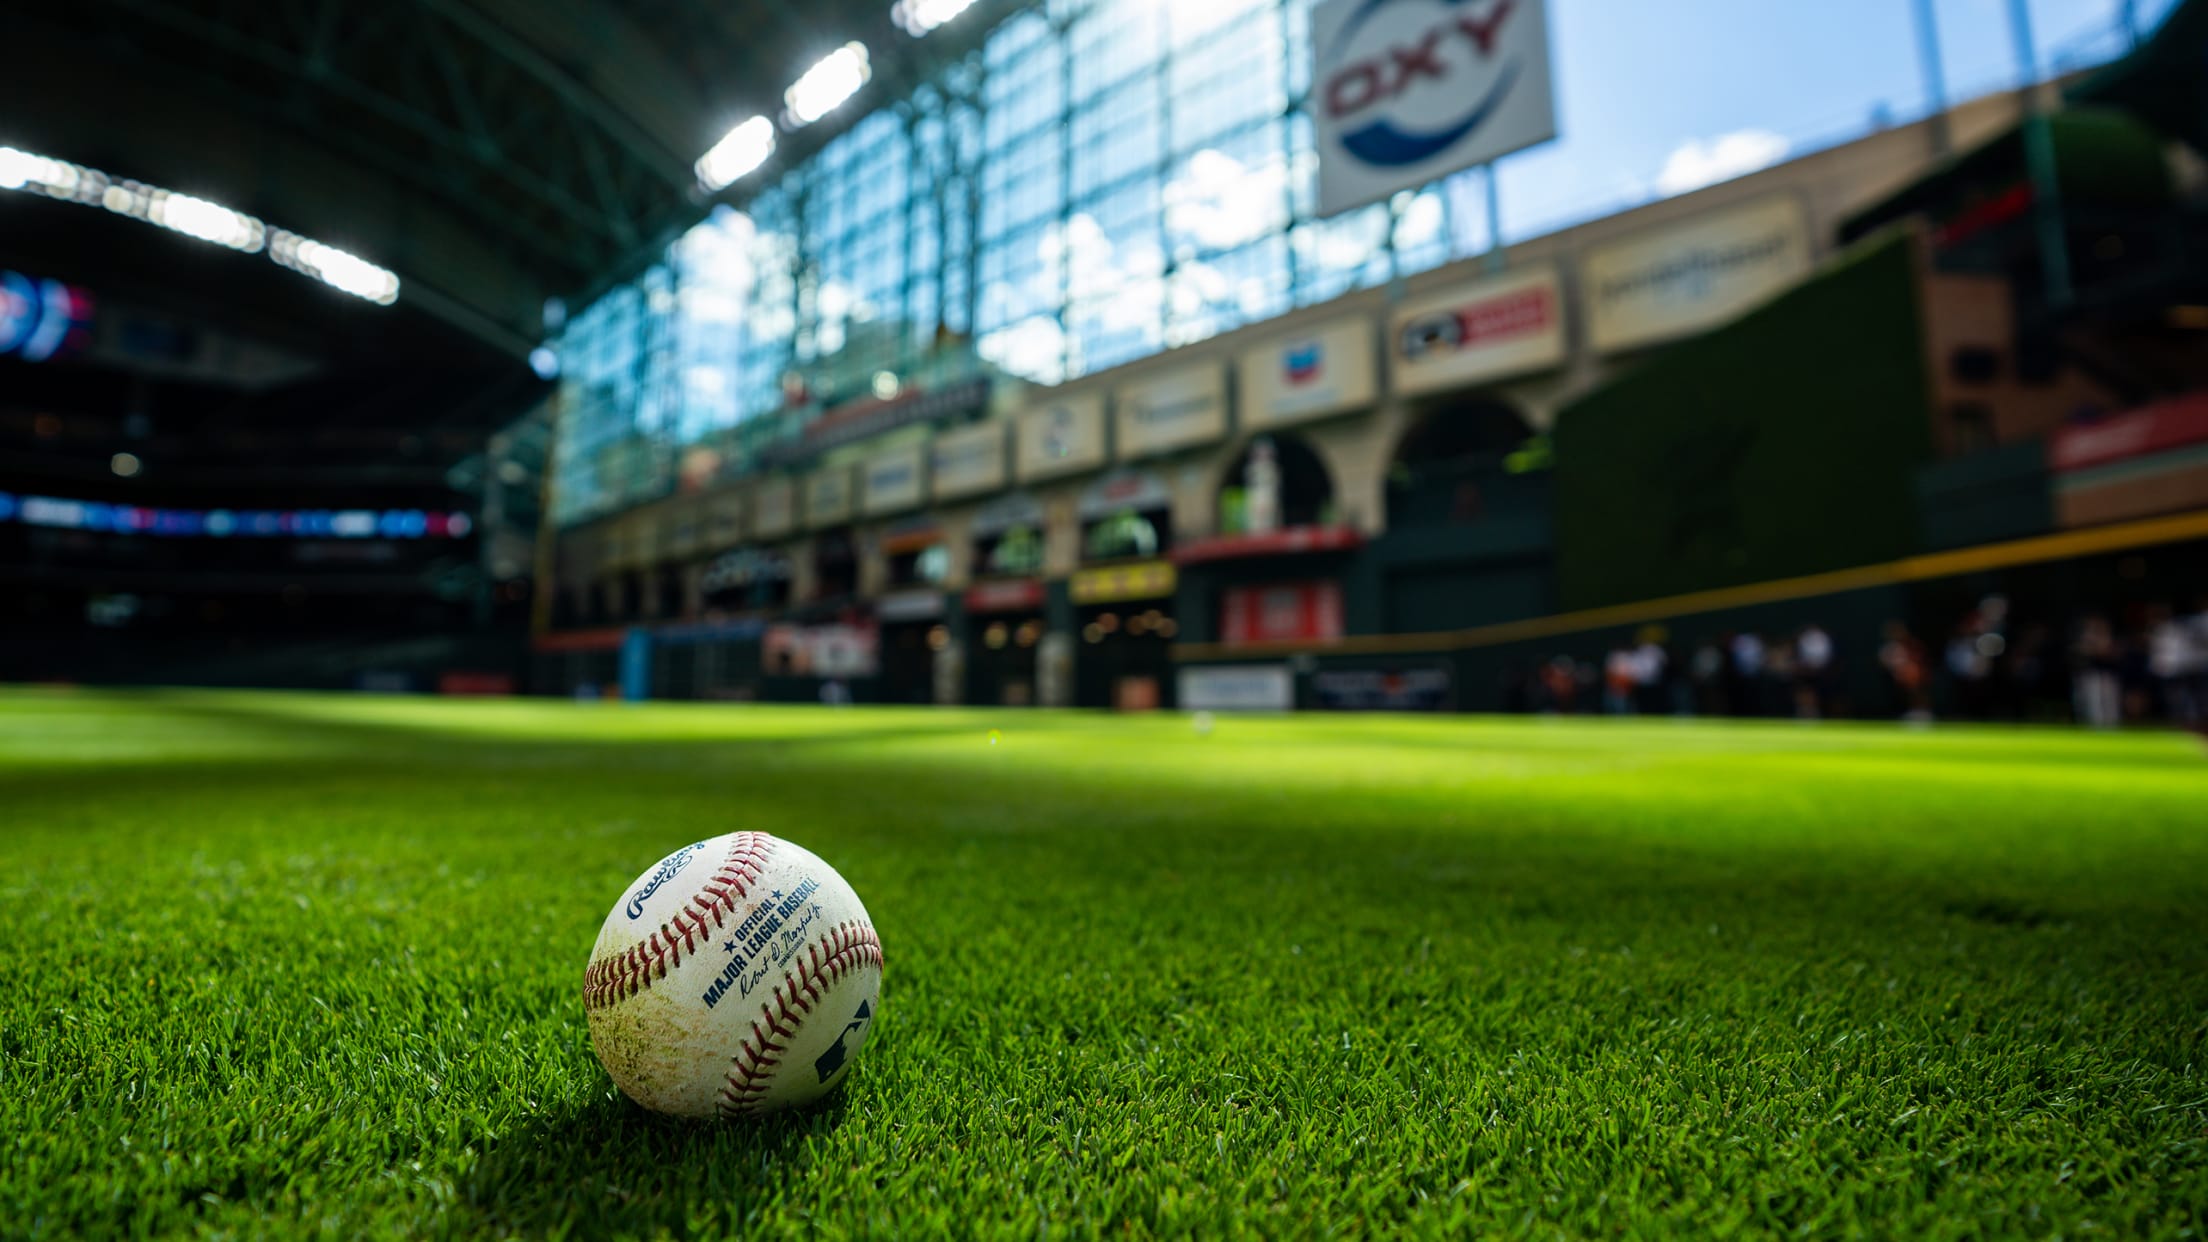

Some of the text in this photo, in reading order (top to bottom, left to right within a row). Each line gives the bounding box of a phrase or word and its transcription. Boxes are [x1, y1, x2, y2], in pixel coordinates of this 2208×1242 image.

[1325, 0, 1516, 118] OXY
[626, 843, 705, 920] Rawling
[734, 899, 776, 942] OFFICIAL
[702, 877, 820, 1009] MAJOR LEAGUE BASEBALL
